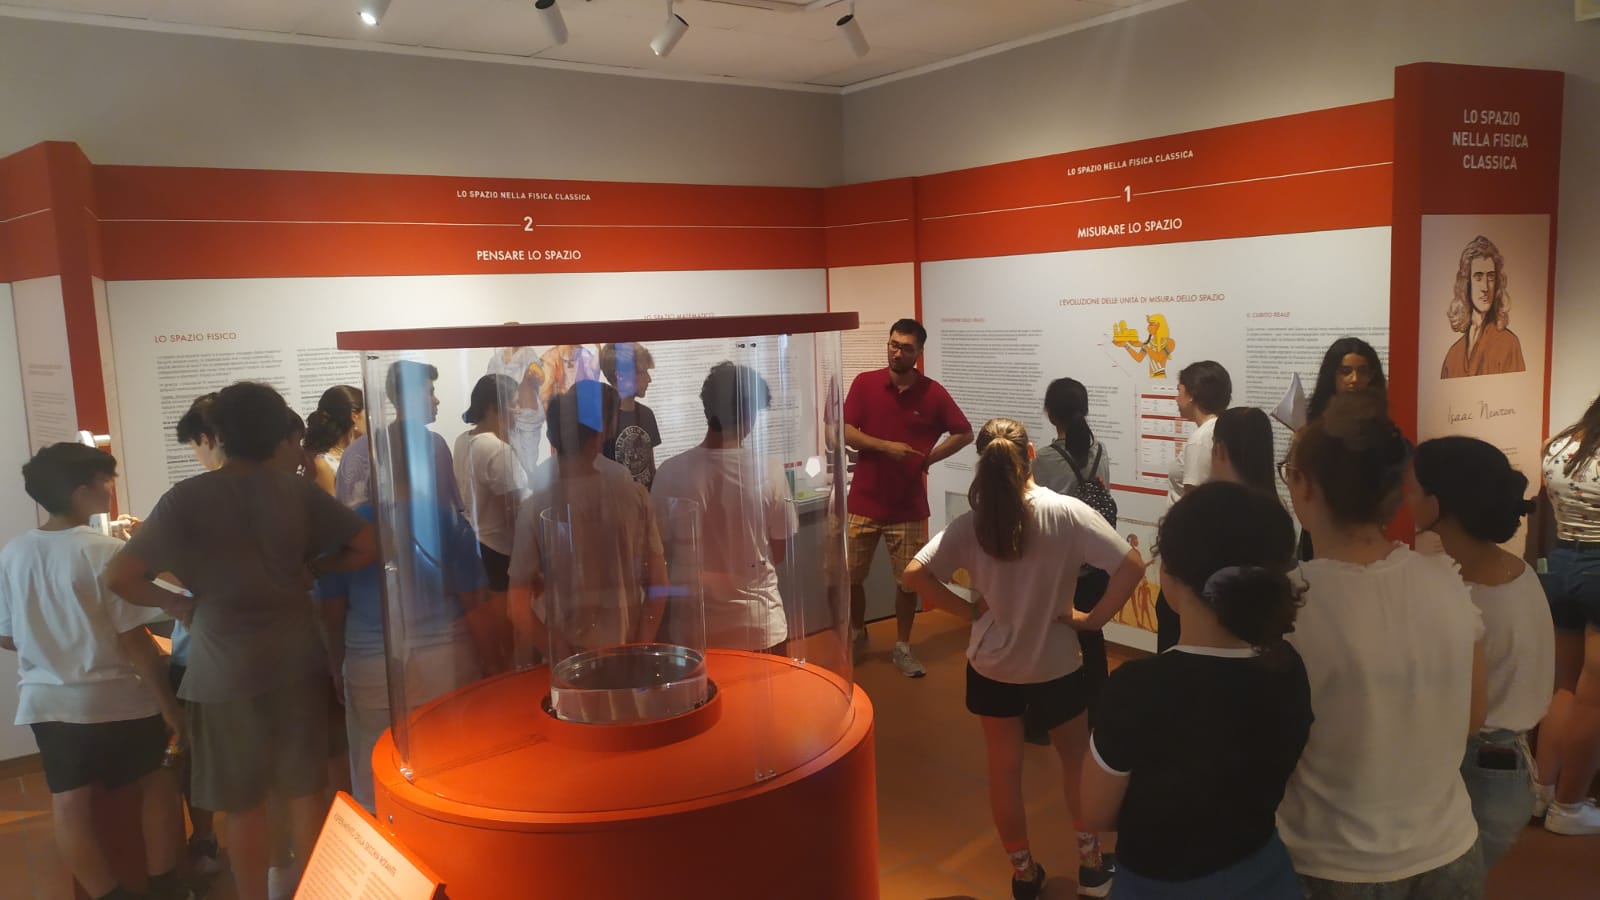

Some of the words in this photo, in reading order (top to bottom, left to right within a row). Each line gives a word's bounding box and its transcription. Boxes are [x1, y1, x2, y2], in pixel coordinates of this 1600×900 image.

[1463, 109, 1478, 124] LO
[1480, 110, 1521, 126] SPAZIO
[1452, 131, 1490, 147] NELLA
[1493, 133, 1529, 148] FISICA
[1067, 168, 1076, 176] LO
[1077, 165, 1102, 175] SPAZIO
[1103, 160, 1127, 171] NELLA
[1129, 156, 1154, 167] FISICA
[1155, 150, 1194, 163] CLASSICA
[1463, 154, 1518, 170] CLASSICA
[457, 190, 467, 198] LO
[469, 190, 498, 199] SPAZIO
[500, 191, 526, 200] NELLA
[528, 192, 554, 200] FISICA
[555, 193, 591, 201] CLASSICA
[1124, 185, 1131, 203] 1
[523, 215, 534, 232] 2
[1077, 223, 1125, 239] MISURARE
[1128, 222, 1142, 234] LO
[1144, 217, 1183, 232] SPAZIO
[476, 250, 525, 261] PENSARE
[528, 250, 542, 261] LO
[544, 249, 582, 260] SPAZIO
[1148, 295, 1175, 303] MISURA
[1175, 294, 1198, 303] DELLO
[1198, 293, 1226, 302] SPAZIO
[154, 335, 168, 344] LO
[170, 333, 205, 343] SPAZIO
[207, 332, 238, 341] FISICO
[1448, 405, 1473, 425] Isaac
[1480, 400, 1517, 419] Newton
